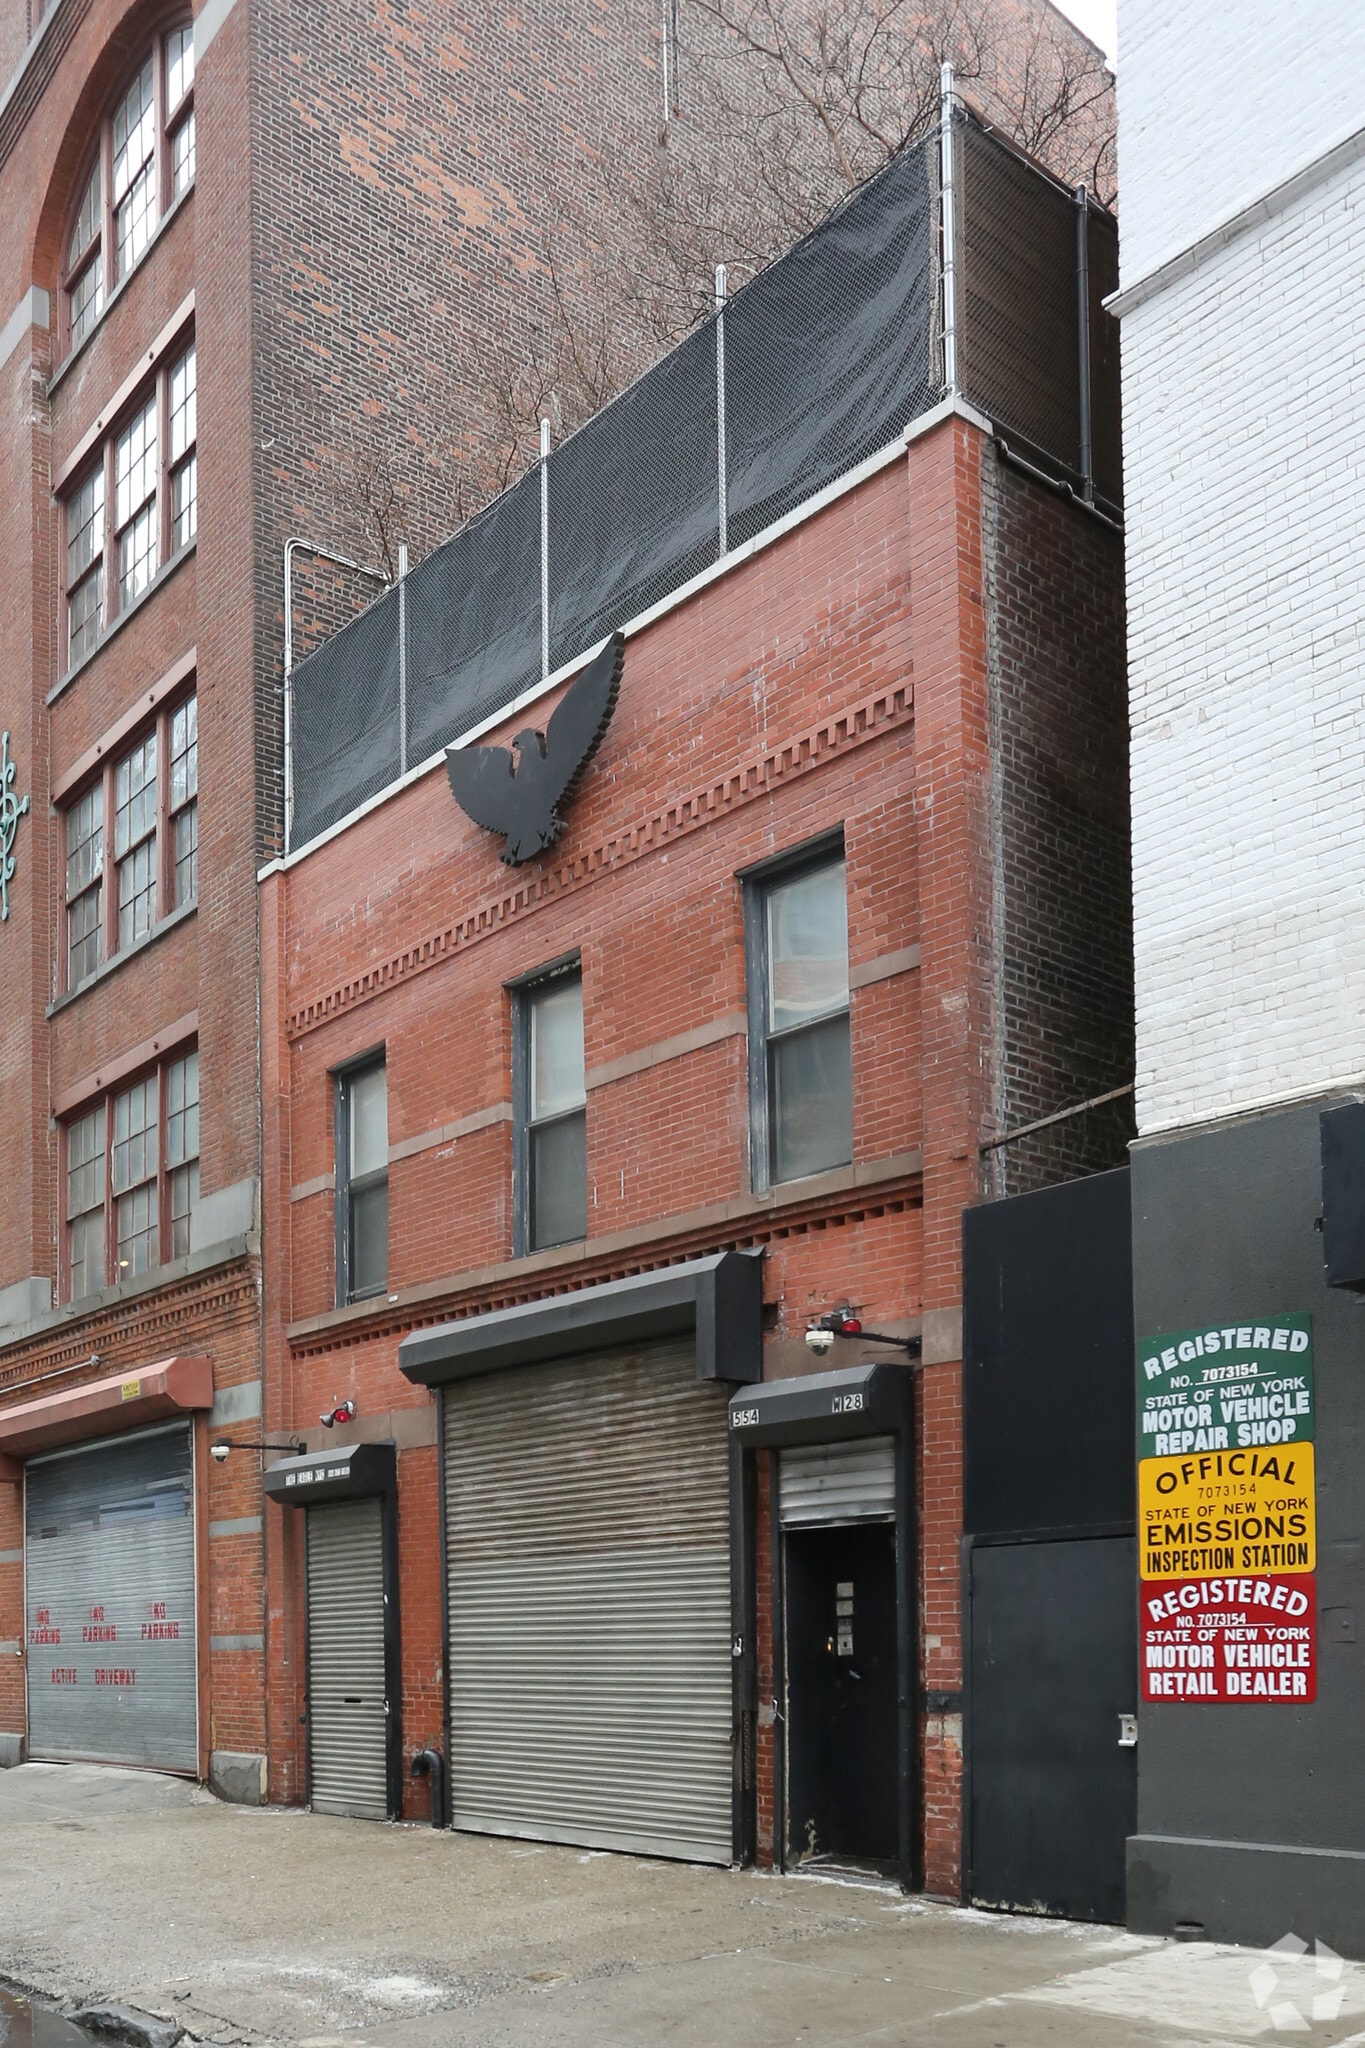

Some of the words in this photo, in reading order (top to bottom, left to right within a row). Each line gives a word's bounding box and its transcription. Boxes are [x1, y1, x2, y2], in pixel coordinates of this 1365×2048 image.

[1143, 1327, 1309, 1380] REGISTERED
[1170, 1375, 1194, 1388] NO.
[1202, 1362, 1259, 1381] 7073154
[1145, 1393, 1188, 1409] STATE
[1193, 1389, 1215, 1403] OF
[1220, 1383, 1256, 1399] NEW
[1261, 1376, 1305, 1393] YORK
[733, 1409, 759, 1427] 554
[1143, 1404, 1212, 1434] MOTOR
[1220, 1391, 1310, 1423] VEHICLE
[1155, 1426, 1228, 1456] REPAIR
[1237, 1418, 1296, 1447] SHOP
[1156, 1453, 1296, 1495] OFFICIAL
[1198, 1483, 1256, 1499] 7073154
[1145, 1507, 1190, 1521] STATE
[1197, 1505, 1217, 1517] OF
[1224, 1502, 1257, 1515] NEW
[1264, 1498, 1309, 1512] YORK
[1147, 1514, 1307, 1547] EMISSIONS
[1147, 1547, 1234, 1573] INSPECTION
[1242, 1543, 1308, 1568] STATION
[153, 1602, 166, 1619] NO
[1147, 1579, 1309, 1623] REGISTERED
[141, 1622, 179, 1640] PARKING
[1176, 1615, 1195, 1628] NO.
[1197, 1612, 1247, 1626] 7073154
[30, 1628, 61, 1645] PARKING
[82, 1625, 117, 1643] PARKING
[1146, 1630, 1191, 1642] STATE
[1197, 1629, 1218, 1641] OF
[1224, 1628, 1258, 1641] NEW
[1265, 1627, 1310, 1640] YORK
[1146, 1644, 1215, 1668] MOTOR
[1223, 1643, 1310, 1668] VEHICLE
[51, 1668, 77, 1684] ACTIVE
[94, 1668, 136, 1685] DRIVEWAY
[1150, 1672, 1218, 1695] RETAIL
[1226, 1672, 1307, 1696] DEALER
